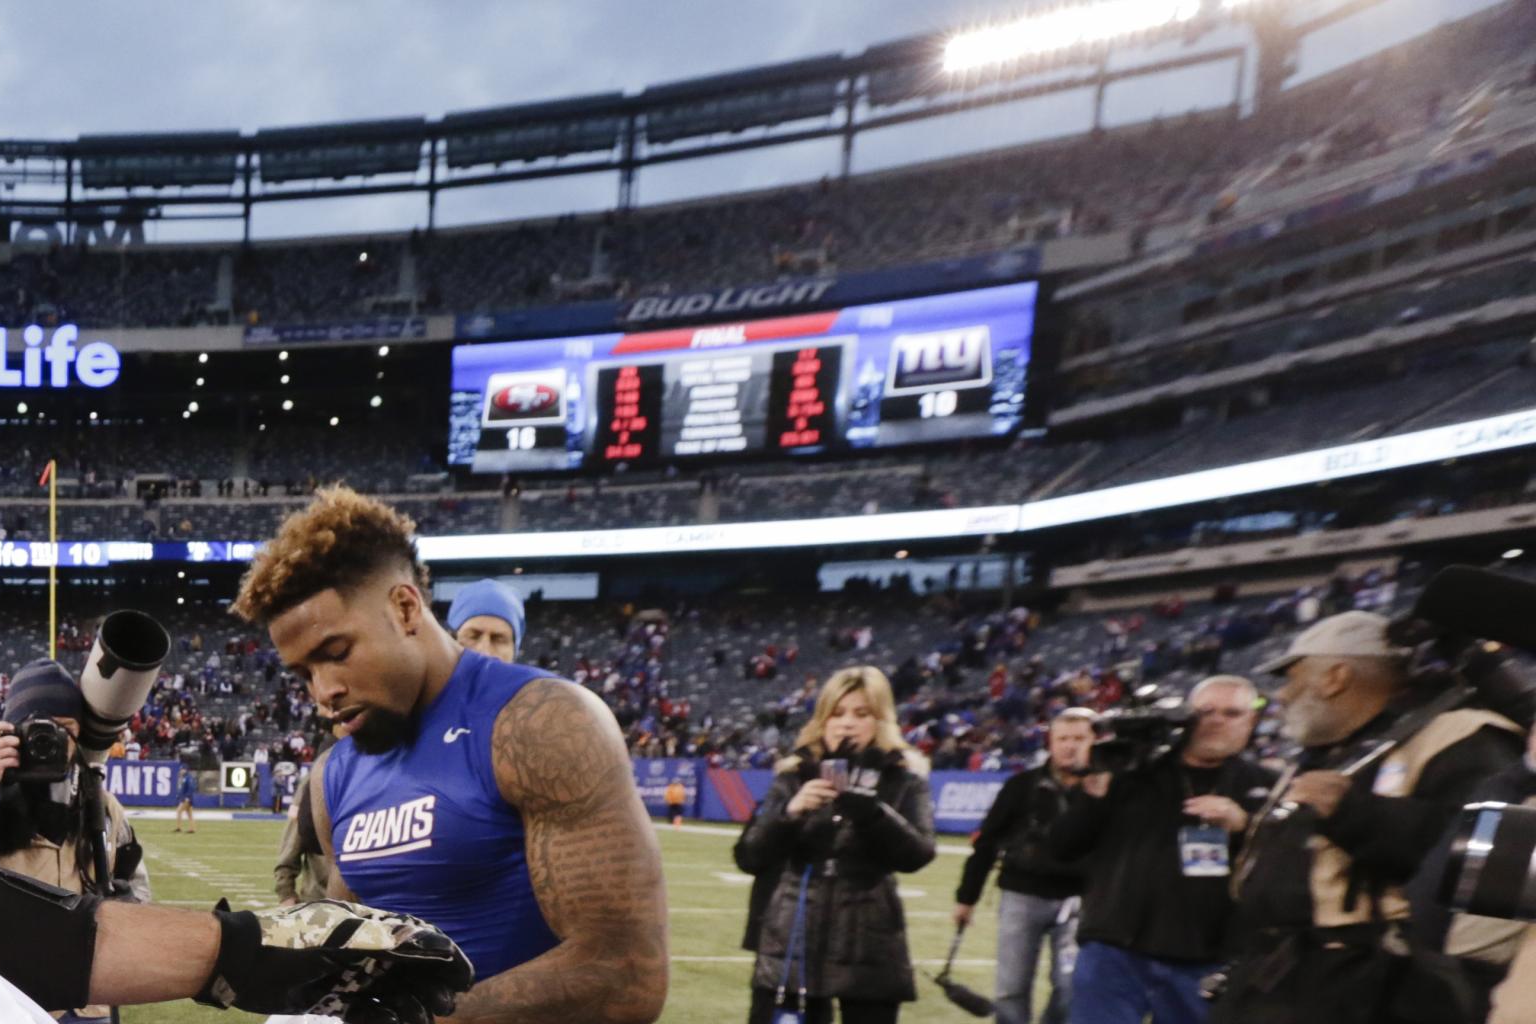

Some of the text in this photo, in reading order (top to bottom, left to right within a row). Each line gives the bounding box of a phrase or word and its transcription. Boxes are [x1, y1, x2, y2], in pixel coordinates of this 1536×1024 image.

[627, 278, 835, 321] BUD LIGHT
[690, 325, 747, 349] FINAL
[69, 543, 101, 565] 10
[231, 767, 247, 788] 0
[343, 795, 436, 853] GIANTS
